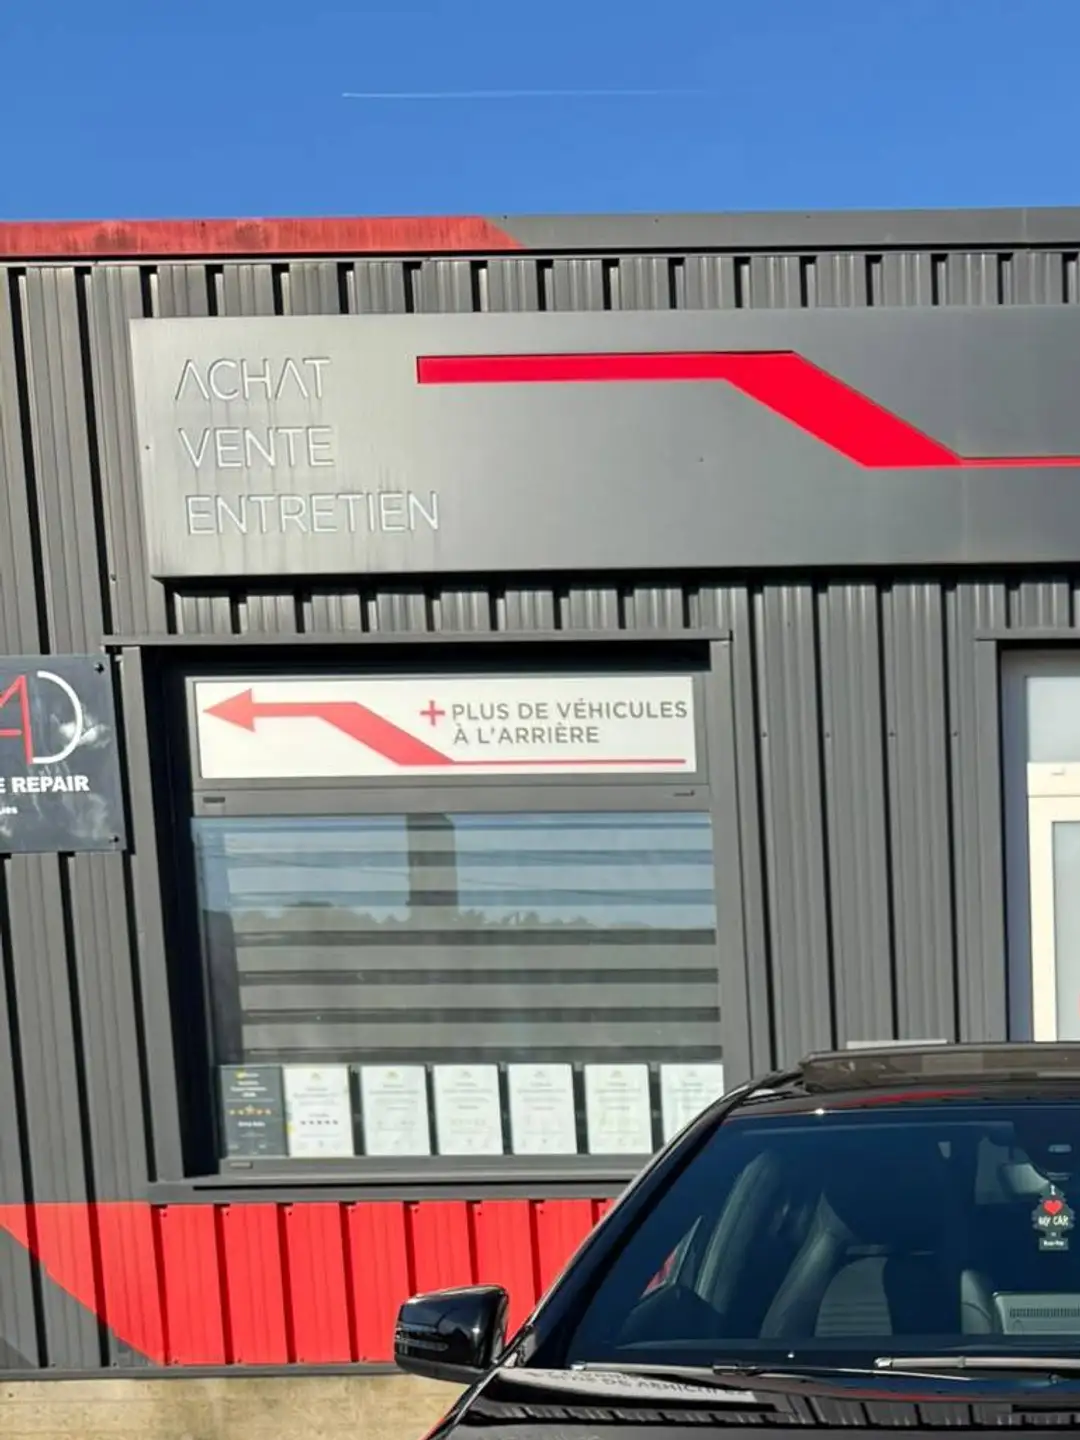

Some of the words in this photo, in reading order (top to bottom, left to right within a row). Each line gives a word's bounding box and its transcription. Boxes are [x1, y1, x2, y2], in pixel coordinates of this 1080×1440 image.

[175, 357, 330, 401] ACHAT
[178, 426, 335, 469] VENTE
[185, 491, 439, 535] ENTRETIEN
[452, 702, 510, 721] PLUS
[518, 702, 549, 720] DE
[557, 698, 688, 720] VÉHICULES
[453, 723, 469, 745] À
[478, 722, 601, 745] L'ARRIÈRE
[11, 775, 91, 793] REPAIR
[1038, 1215, 1051, 1227] MY
[1053, 1215, 1069, 1226] CAR
